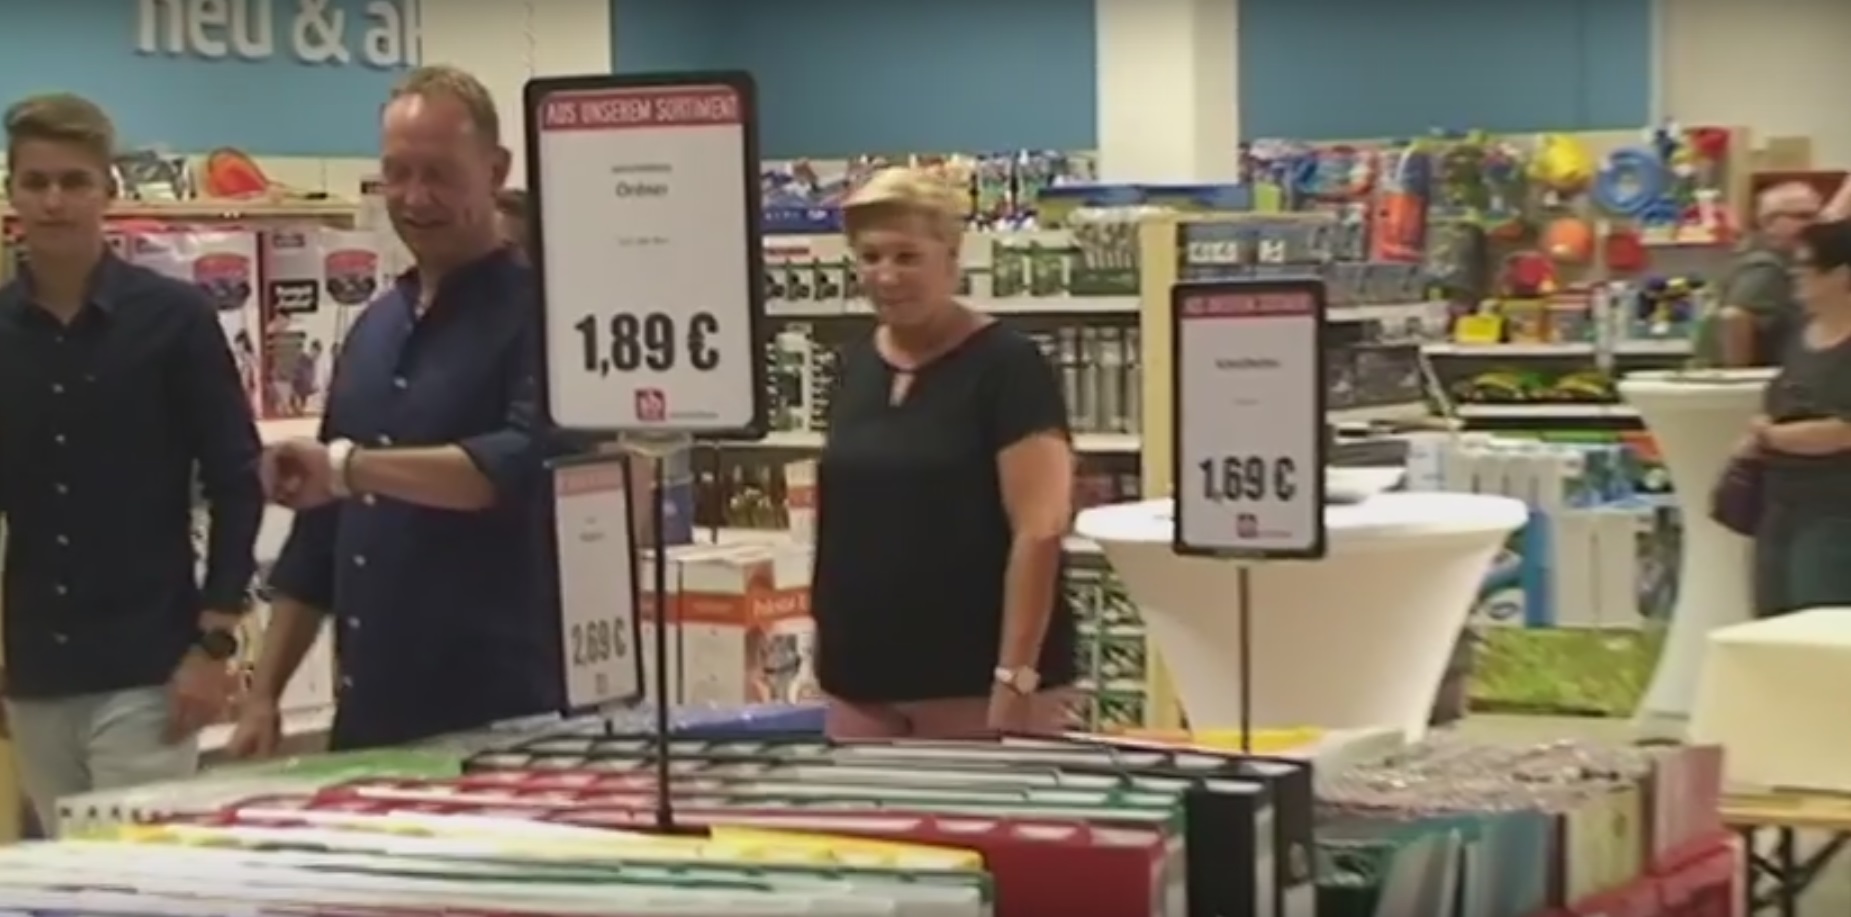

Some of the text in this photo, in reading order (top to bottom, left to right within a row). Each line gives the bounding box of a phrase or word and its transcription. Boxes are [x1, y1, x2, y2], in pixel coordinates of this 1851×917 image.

[138, 0, 273, 56] neu
[292, 0, 350, 63] &
[546, 94, 739, 125] AUS UNSEREM SORTIMENT
[574, 311, 719, 378] 1,89 €
[1199, 456, 1265, 504] 1,69
